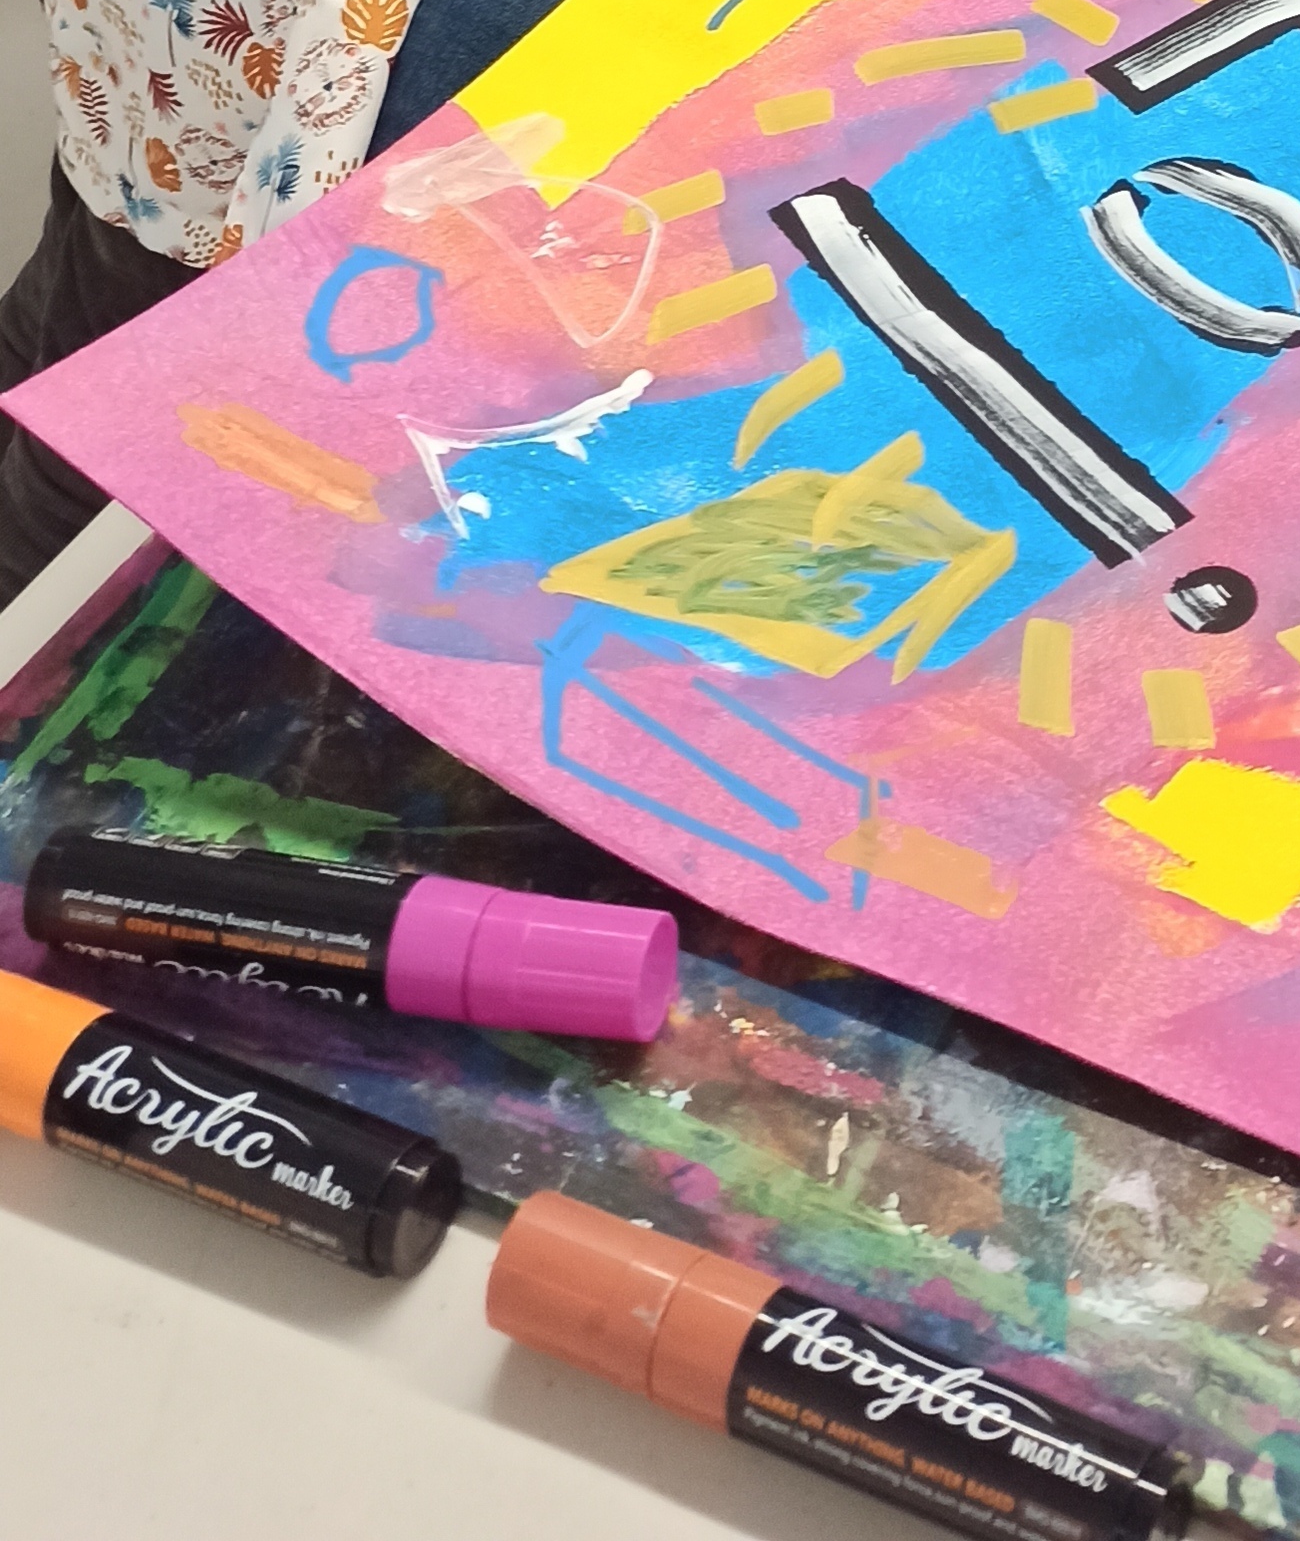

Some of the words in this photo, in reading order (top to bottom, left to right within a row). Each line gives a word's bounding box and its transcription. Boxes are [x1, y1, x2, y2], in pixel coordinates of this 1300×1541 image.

[64, 1045, 311, 1169] Acrylic
[274, 1161, 352, 1210] marker
[763, 1308, 1053, 1441] Acrylic
[1011, 1430, 1108, 1492] marker
